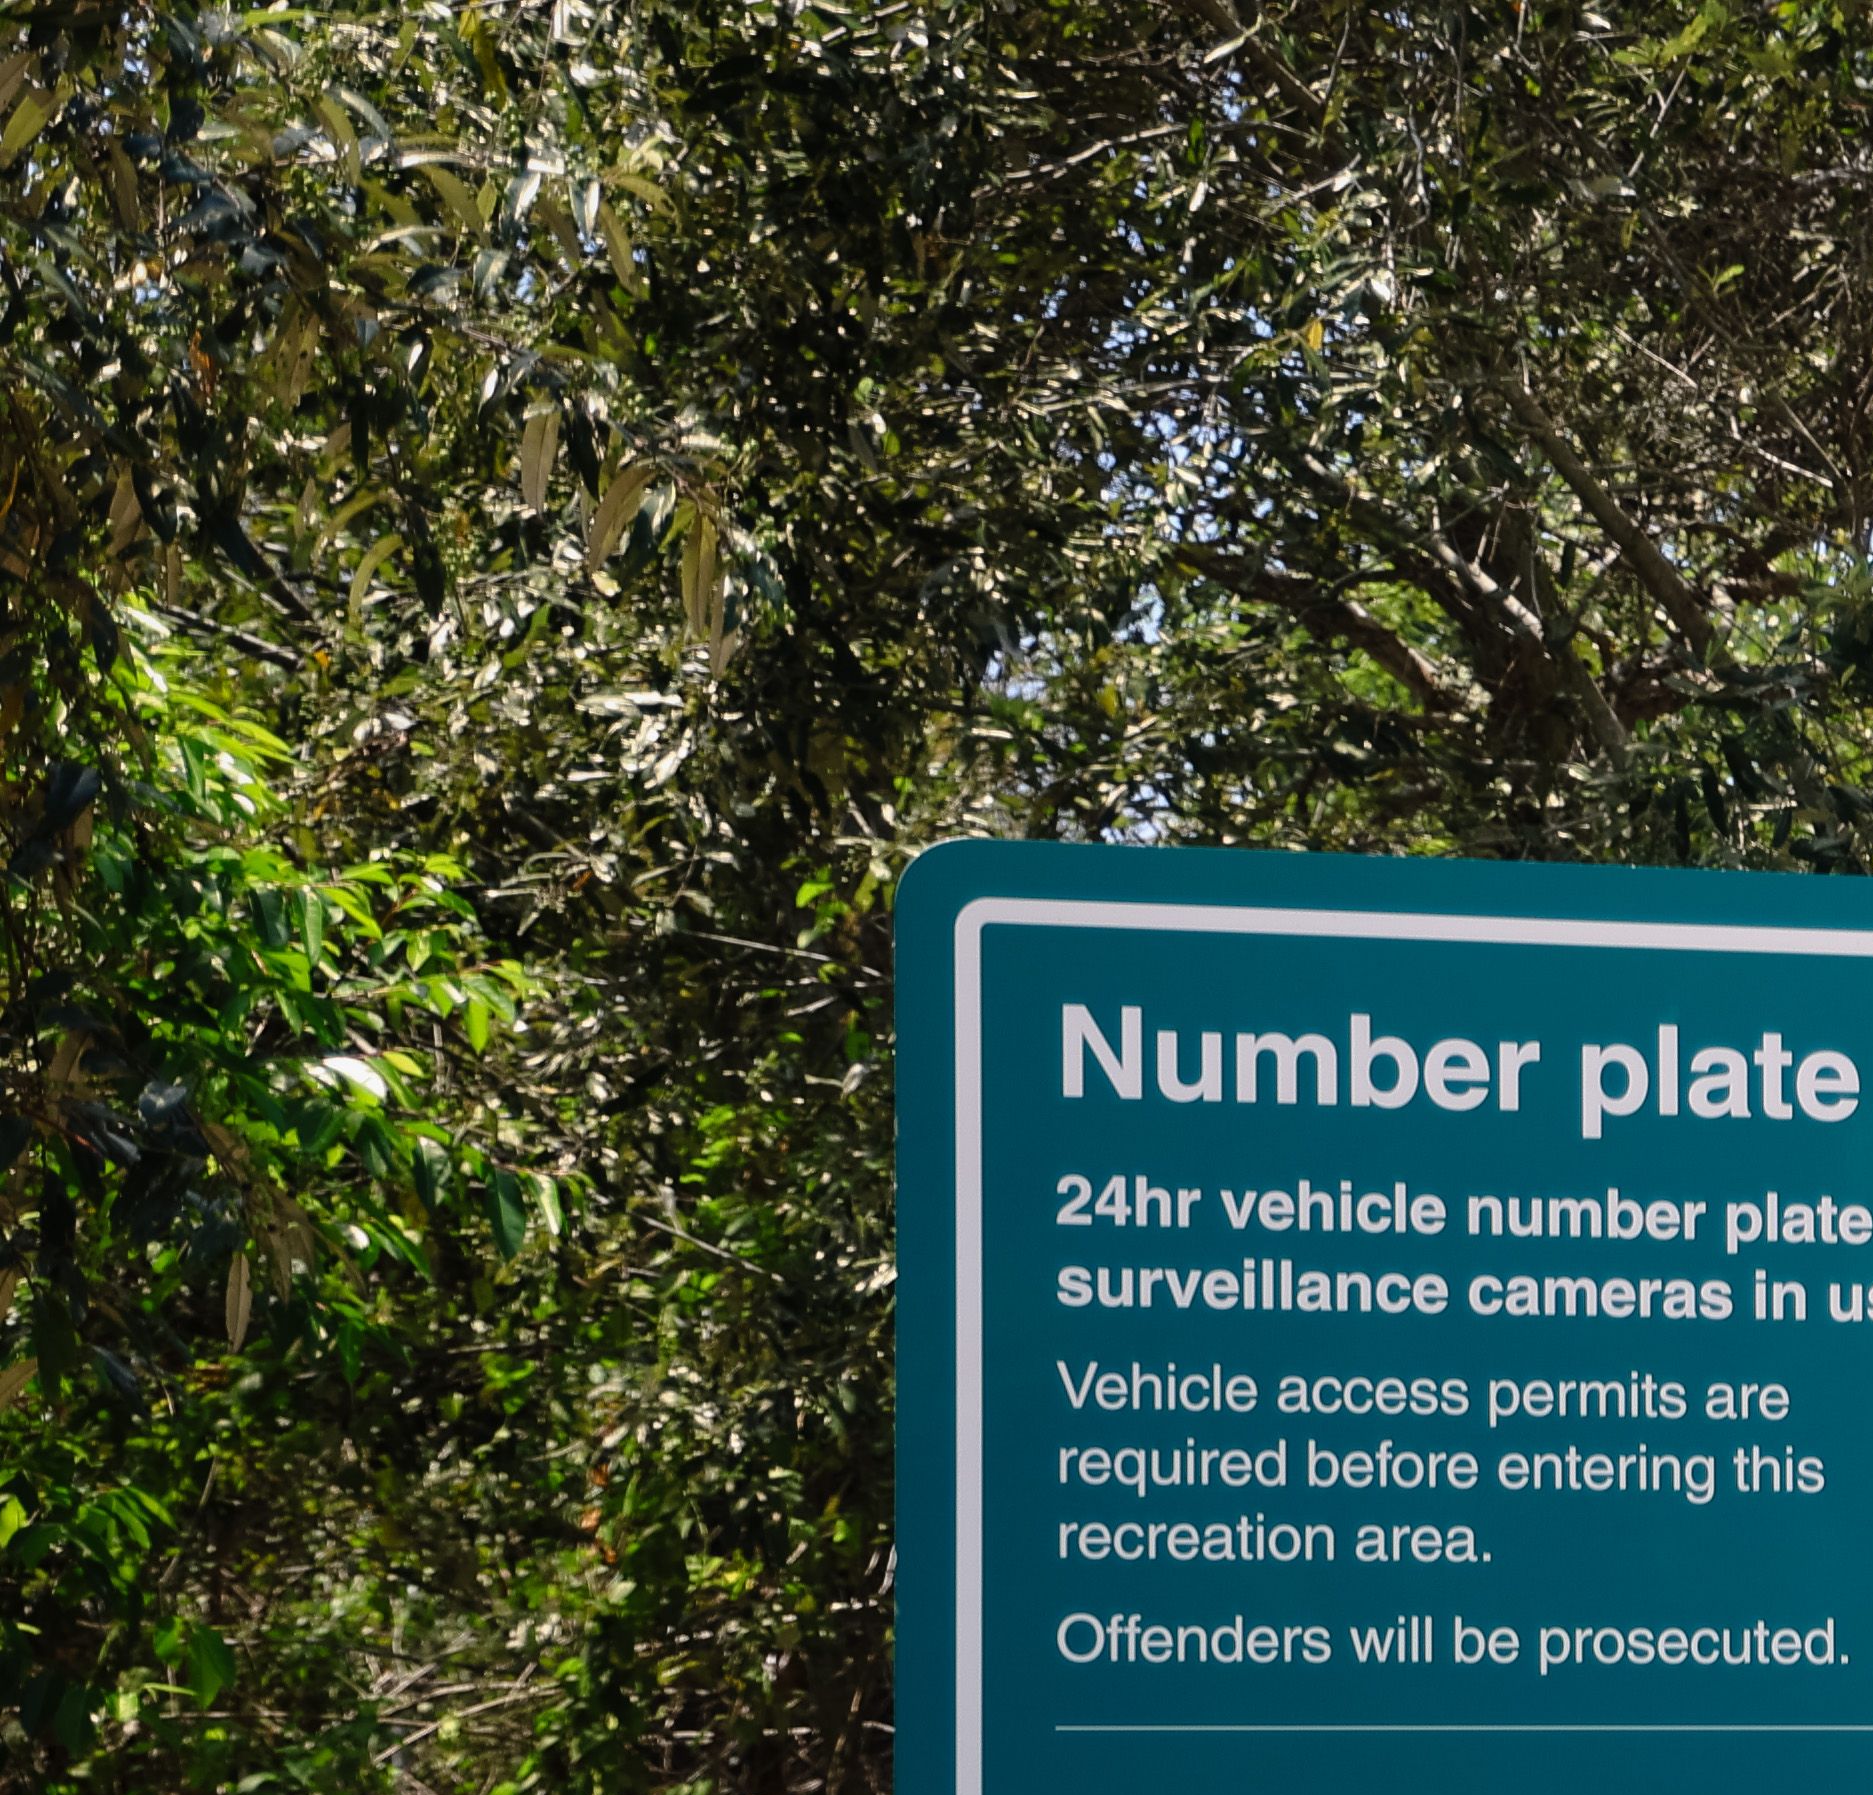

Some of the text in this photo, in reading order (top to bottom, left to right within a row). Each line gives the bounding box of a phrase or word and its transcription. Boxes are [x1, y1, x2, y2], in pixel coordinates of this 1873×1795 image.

[1063, 1003, 1540, 1111] Number
[1582, 1023, 1859, 1139] plate
[1057, 1174, 1872, 1254] 24hr vehicle number plate
[1057, 1257, 1448, 1314] surveillance
[1469, 1275, 1732, 1320] cameras
[1755, 1269, 1806, 1321] in
[1057, 1361, 1789, 1428] Vehicle access permits are
[1060, 1437, 1824, 1505] required before entering this
[1060, 1513, 1490, 1563] recreation area.
[1057, 1613, 1848, 1676] Offenders will be prosecuted.
